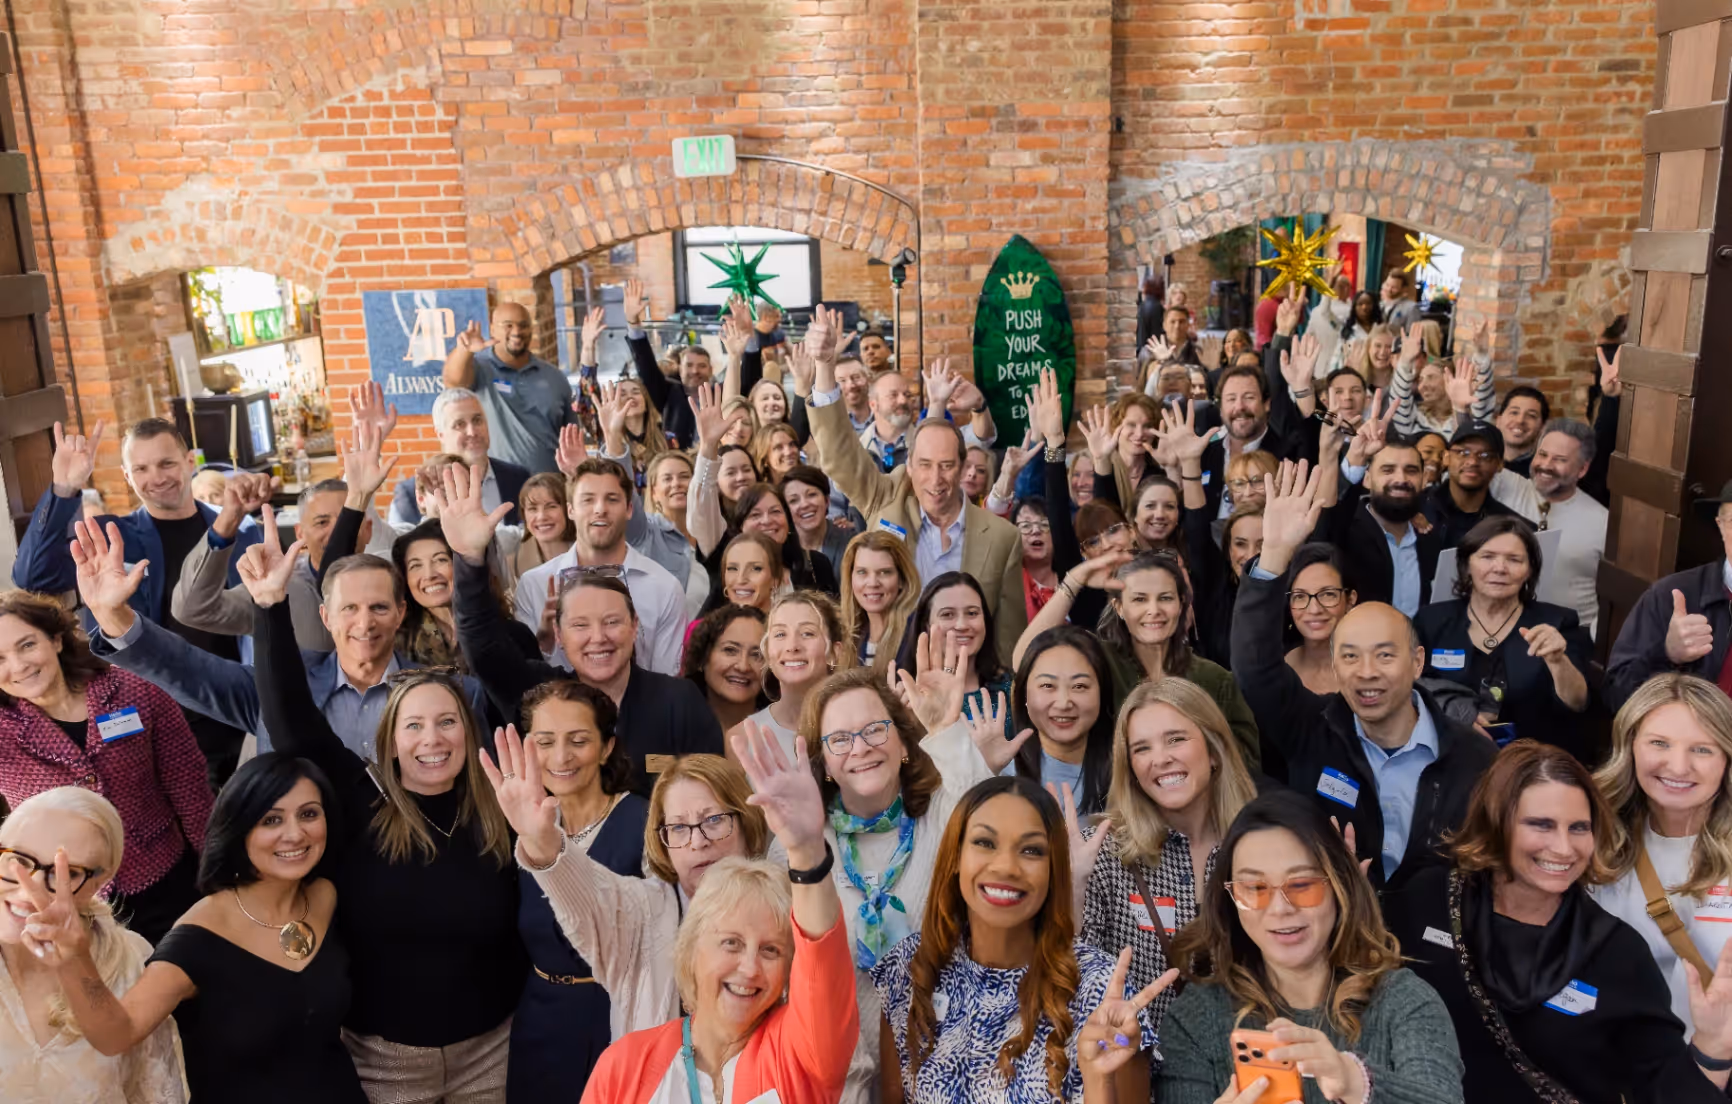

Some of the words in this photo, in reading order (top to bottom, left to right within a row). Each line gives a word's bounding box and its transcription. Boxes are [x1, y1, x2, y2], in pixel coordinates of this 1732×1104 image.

[683, 135, 727, 175] EXIT
[1005, 309, 1042, 331] PUSH
[1004, 334, 1046, 360] YOUR
[384, 373, 446, 395] ALWAYS
[1011, 405, 1028, 419] ED
